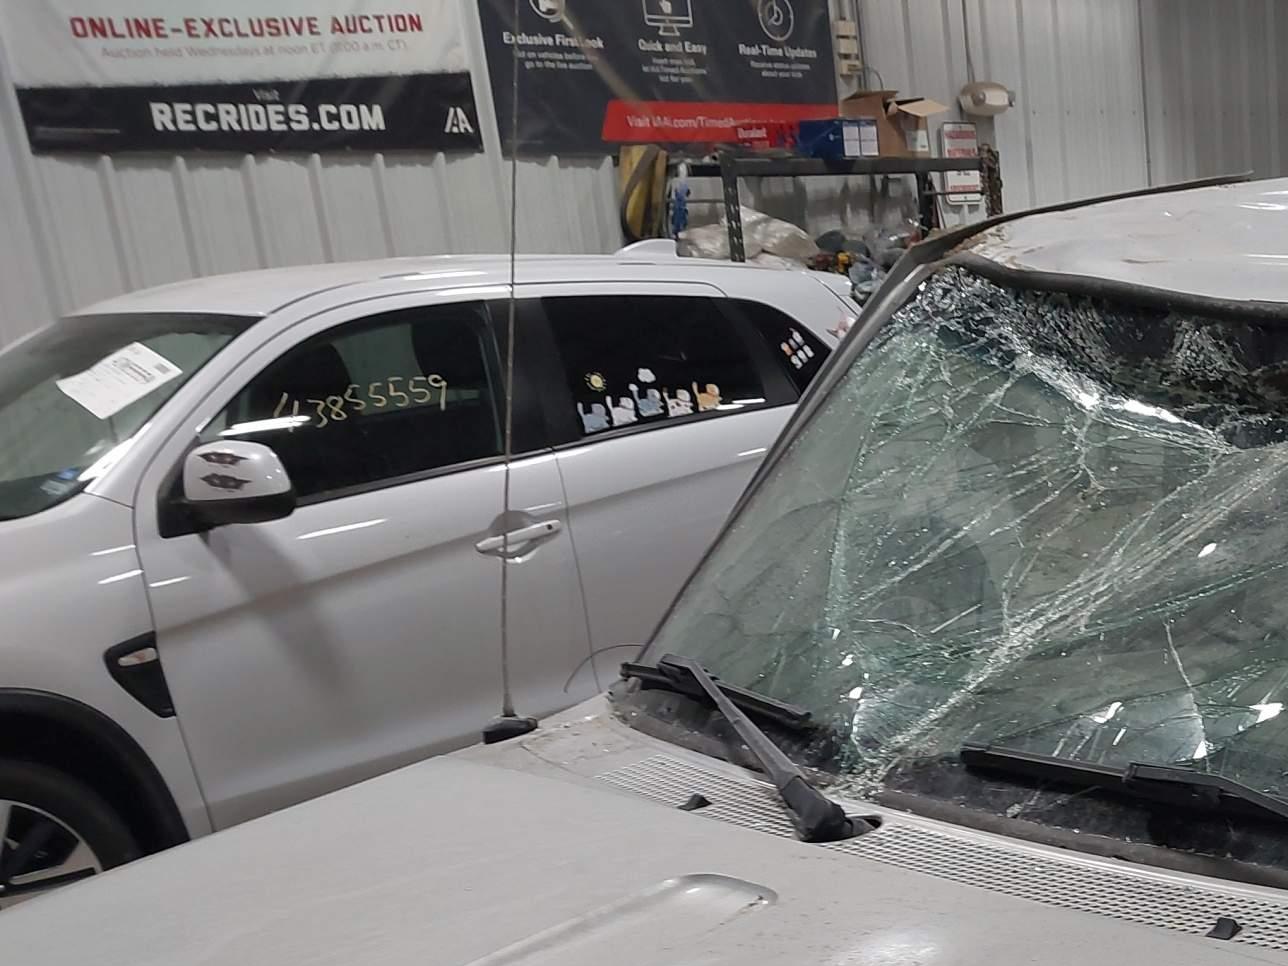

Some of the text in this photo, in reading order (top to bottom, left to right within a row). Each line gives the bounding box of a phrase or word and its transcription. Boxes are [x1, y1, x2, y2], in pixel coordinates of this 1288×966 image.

[69, 13, 423, 39] ONLINE-EXCLUSIVE AUCTION
[555, 34, 578, 48] Firs
[638, 38, 707, 55] Quick and Easy
[738, 43, 817, 59] Real-Time Updates
[150, 101, 386, 131] RECRIDES.COM
[626, 114, 650, 128] Visit
[273, 374, 448, 432] 43855559
